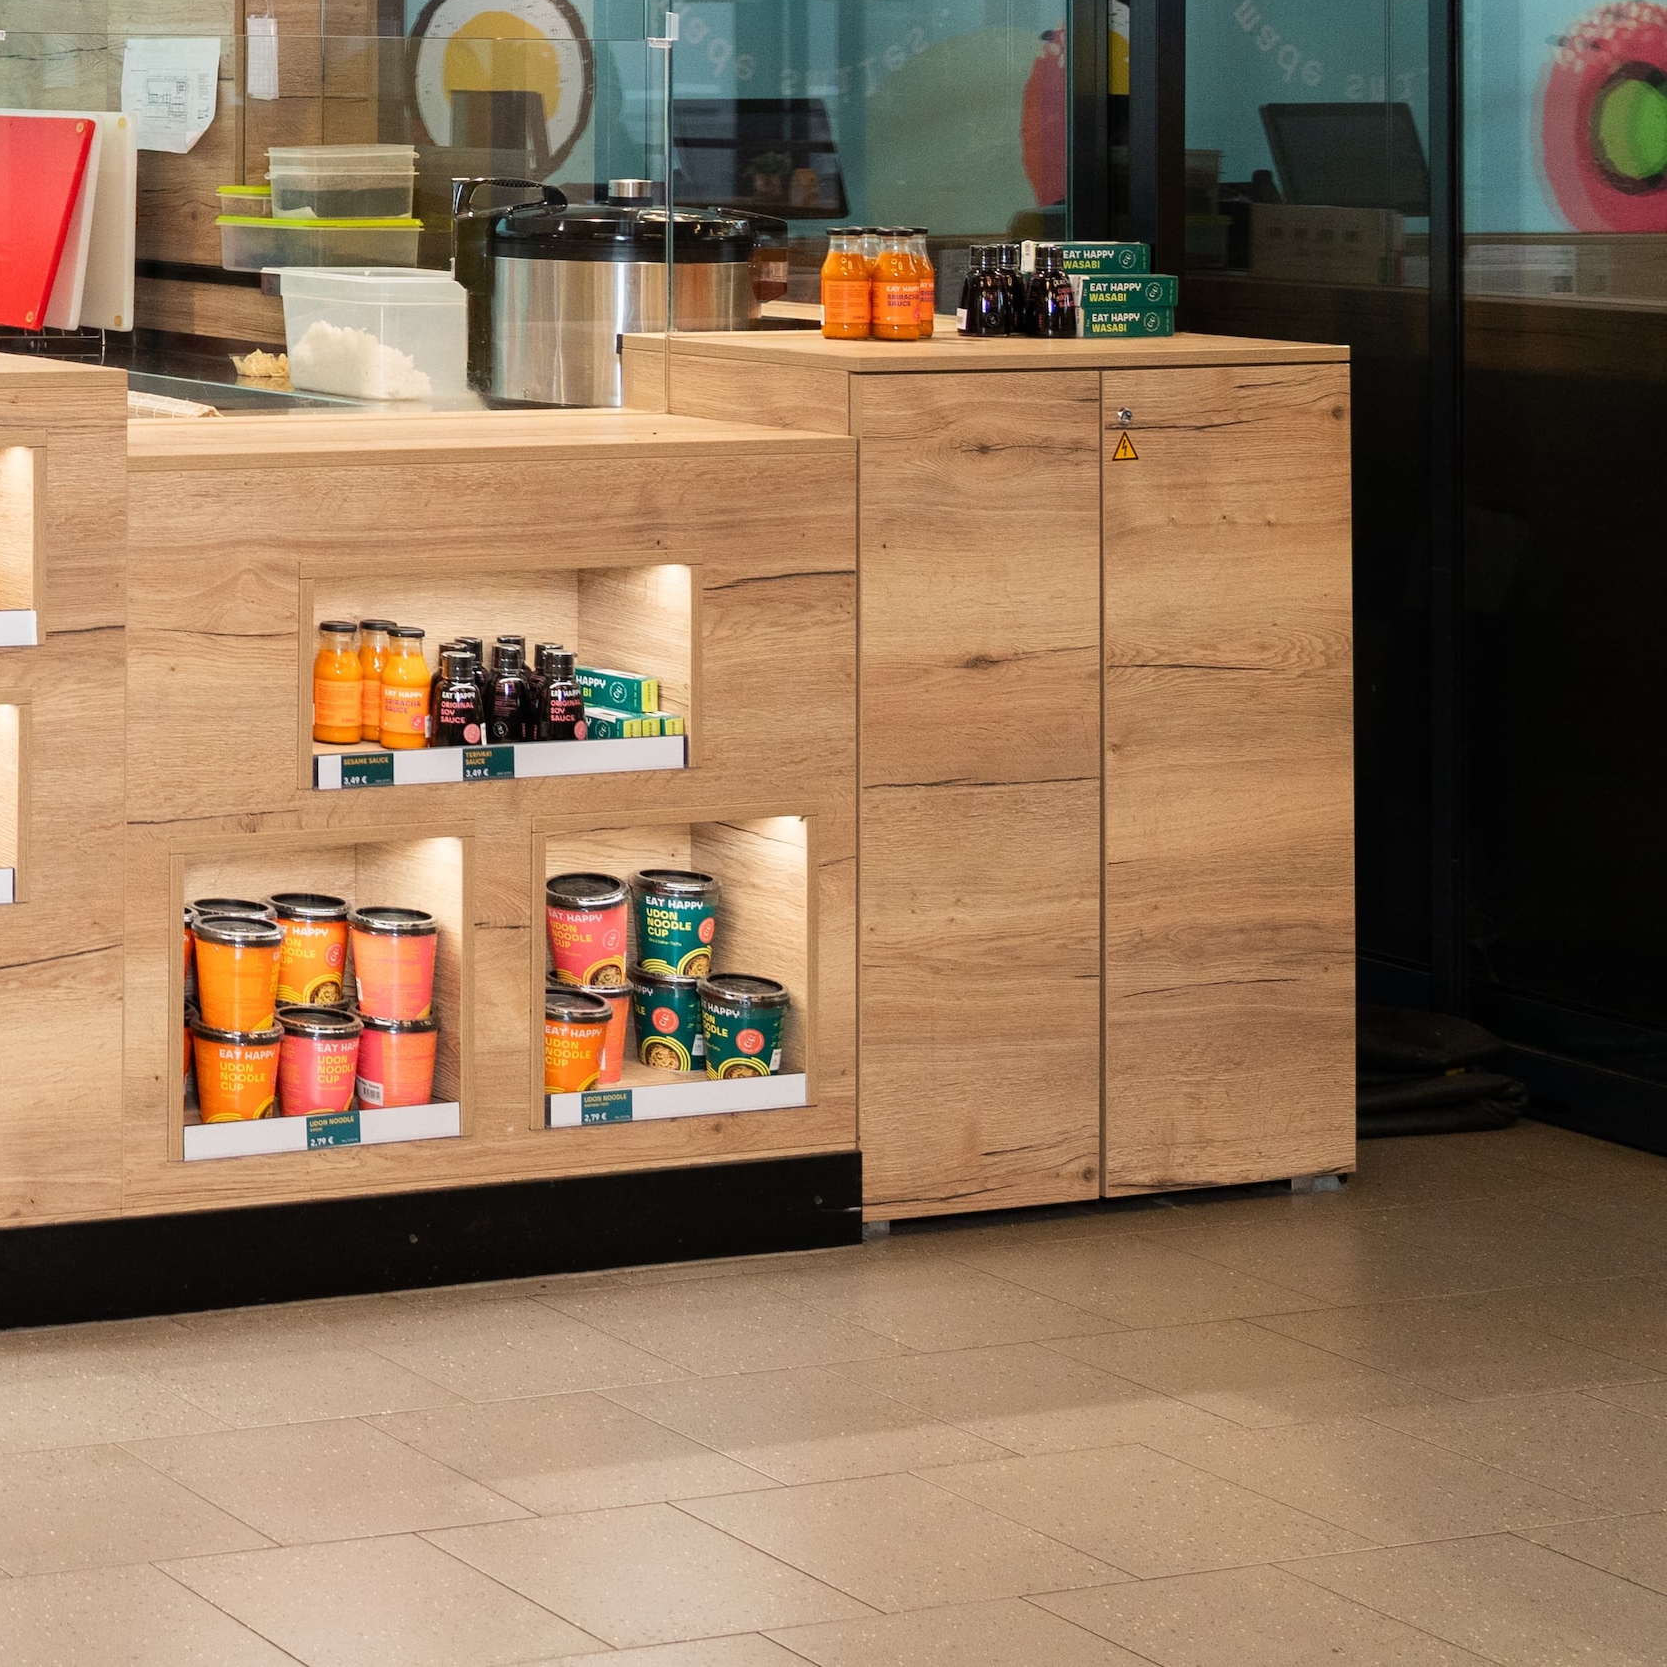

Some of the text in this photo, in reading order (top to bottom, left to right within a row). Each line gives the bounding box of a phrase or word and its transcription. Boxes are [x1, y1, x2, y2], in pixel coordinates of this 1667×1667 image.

[1083, 249, 1115, 259] HAPPY
[1089, 282, 1142, 292] EAT HAPPY
[1089, 293, 1127, 303] WASABI
[1091, 312, 1141, 322] EAT HAPPY
[1091, 323, 1128, 333] WASABI
[575, 674, 607, 689] HAPPY
[384, 697, 422, 707] SRIRACHA
[440, 701, 475, 710] ORIGINAL
[384, 705, 409, 714] SAUCE
[440, 708, 456, 717] SOY
[440, 716, 466, 725] SAUCE
[550, 714, 576, 723] SAUCE
[342, 755, 390, 766] SESAME SAUCE
[465, 769, 483, 778] 3,49
[342, 774, 368, 785] 3,49 €
[644, 895, 704, 911] EAT HAPPY
[646, 908, 678, 921] UDON
[646, 918, 692, 932] NOODLE
[646, 927, 670, 938] CUP
[553, 939, 571, 949] CUP
[218, 1061, 254, 1073] UDON
[545, 1057, 569, 1068] CUP
[219, 1071, 266, 1083] NOODLE
[317, 1073, 340, 1084] CUP
[220, 1081, 245, 1092] CUP
[583, 1092, 628, 1103] UDON NOODLE
[308, 1115, 356, 1129] UDON NOODLE
[584, 1113, 600, 1122] 2,79
[309, 1137, 328, 1147] 2,79
